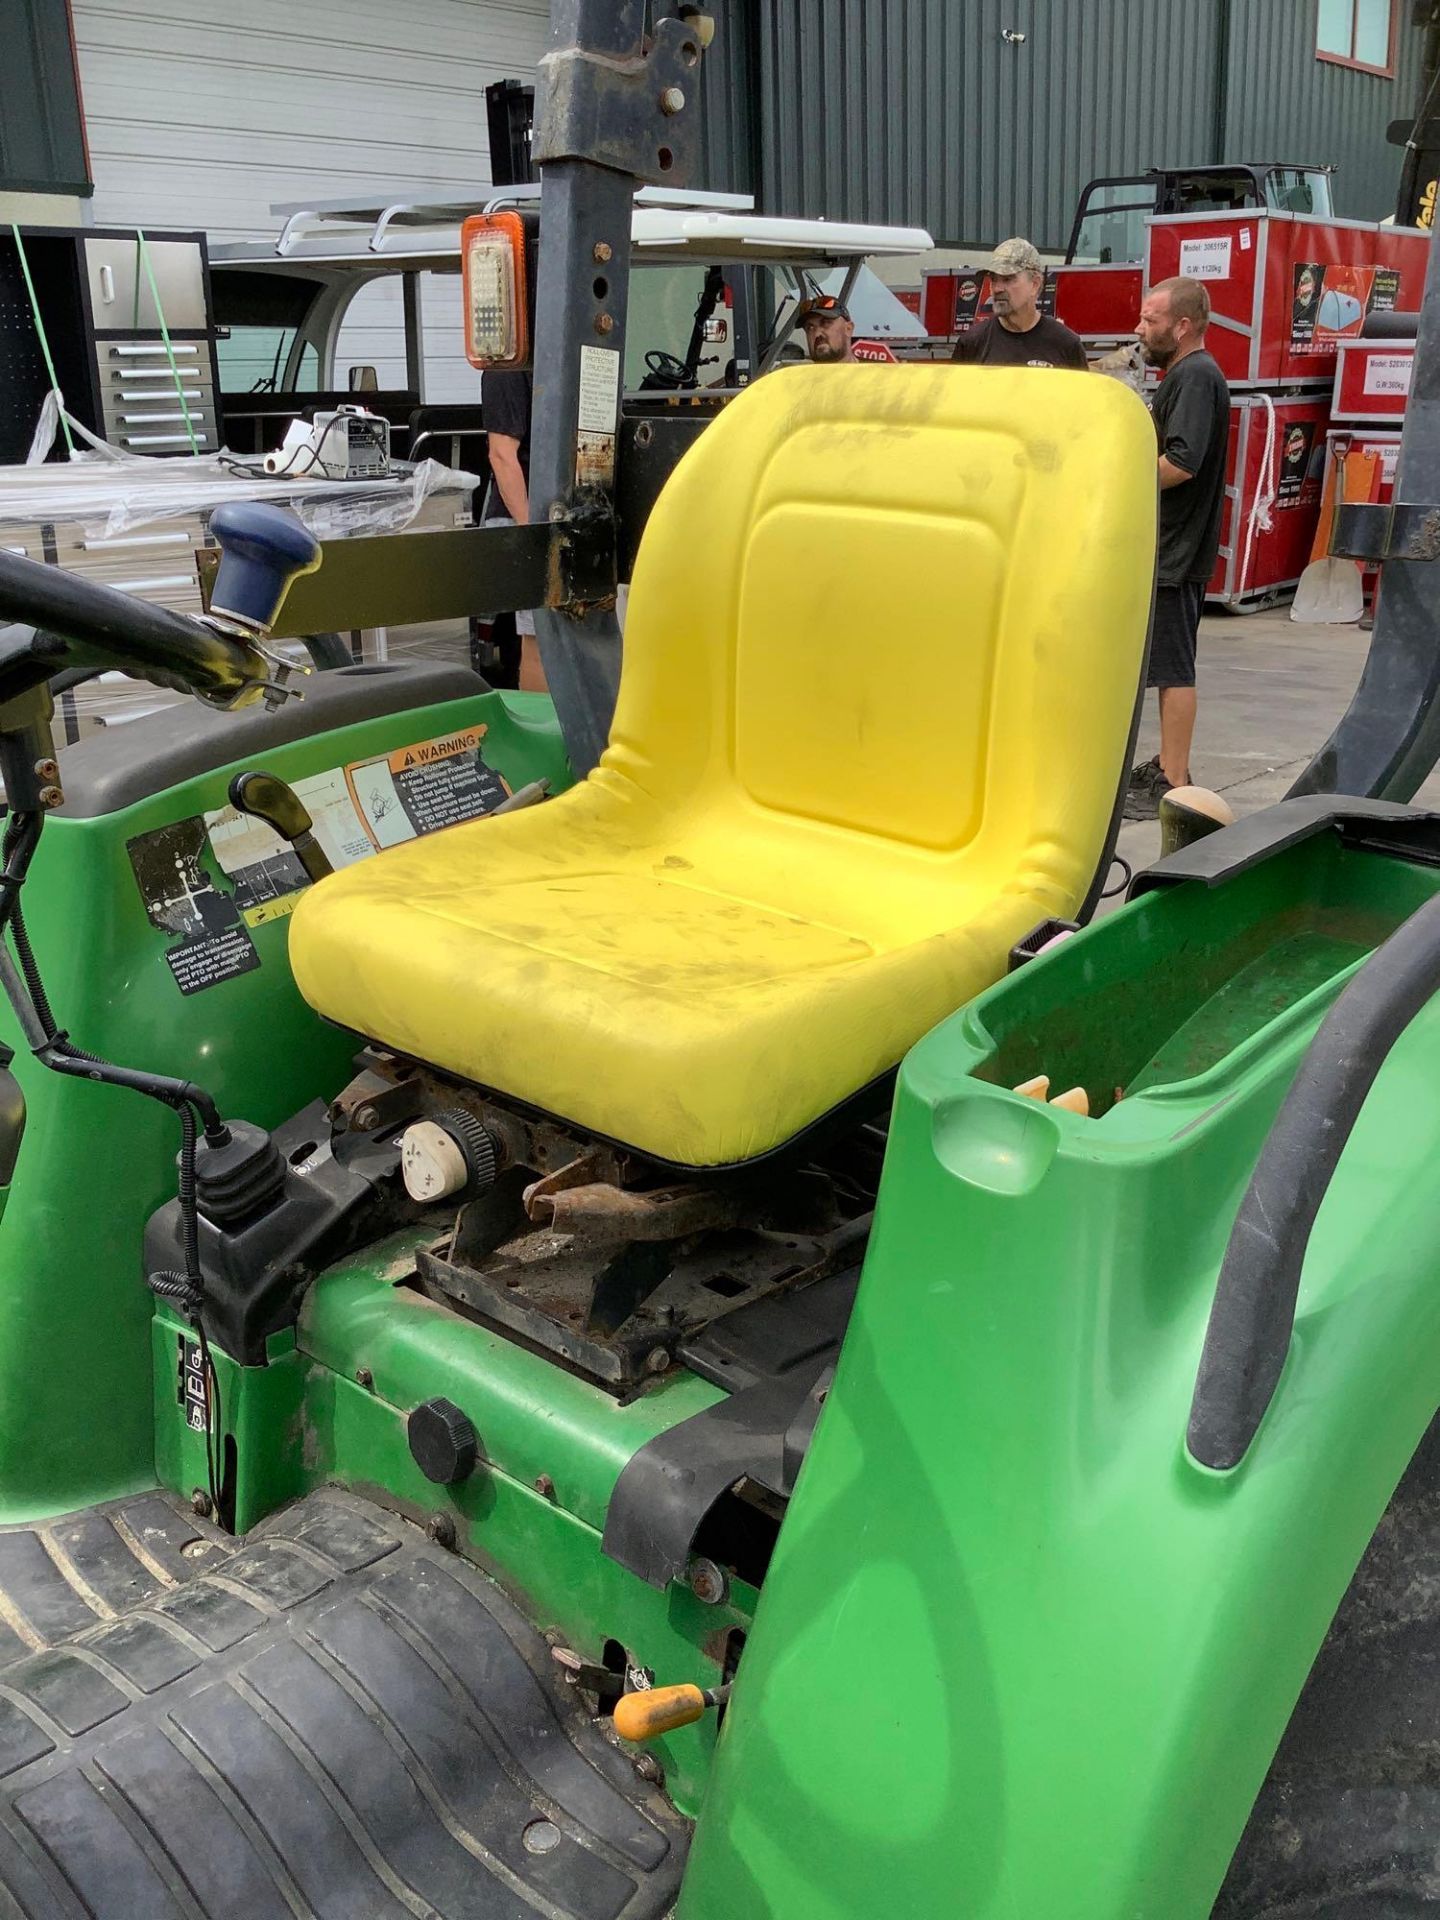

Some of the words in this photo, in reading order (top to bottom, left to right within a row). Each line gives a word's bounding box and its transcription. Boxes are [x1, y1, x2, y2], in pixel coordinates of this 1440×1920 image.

[854, 348, 887, 360] STOP
[418, 735, 475, 761] WARNING
[399, 769, 419, 783] AVOID
[408, 777, 424, 787] Keep
[448, 762, 476, 776] Protective
[411, 782, 438, 795] Structure
[438, 777, 451, 787] fully
[451, 769, 478, 782] extended.
[414, 793, 423, 802] Do
[424, 789, 434, 799] not
[434, 785, 449, 798] jump
[454, 776, 477, 789] machine
[414, 807, 432, 819] When
[432, 799, 458, 812] structure
[458, 794, 472, 804] must
[417, 800, 430, 809] Use
[430, 796, 443, 805] seat
[424, 814, 435, 824] DO
[435, 810, 449, 820] NOT
[448, 807, 460, 816] use
[428, 819, 445, 831] Drive
[445, 815, 458, 825] with
[457, 811, 472, 822] extra
[242, 900, 255, 908] mph
[259, 891, 275, 901] km/h
[212, 938, 220, 946] To
[220, 931, 238, 943] avoid
[172, 955, 197, 971] damage
[197, 952, 205, 960] to
[204, 937, 245, 957] transmission
[175, 966, 190, 978] only
[190, 958, 213, 973] engage
[213, 955, 221, 963] or
[221, 943, 252, 961] disengage
[178, 974, 191, 984] mid
[191, 968, 205, 980] PTO
[206, 962, 220, 974] with
[235, 951, 250, 963] PTO
[181, 983, 189, 992] in
[188, 979, 200, 990] the
[200, 973, 214, 985] OFF
